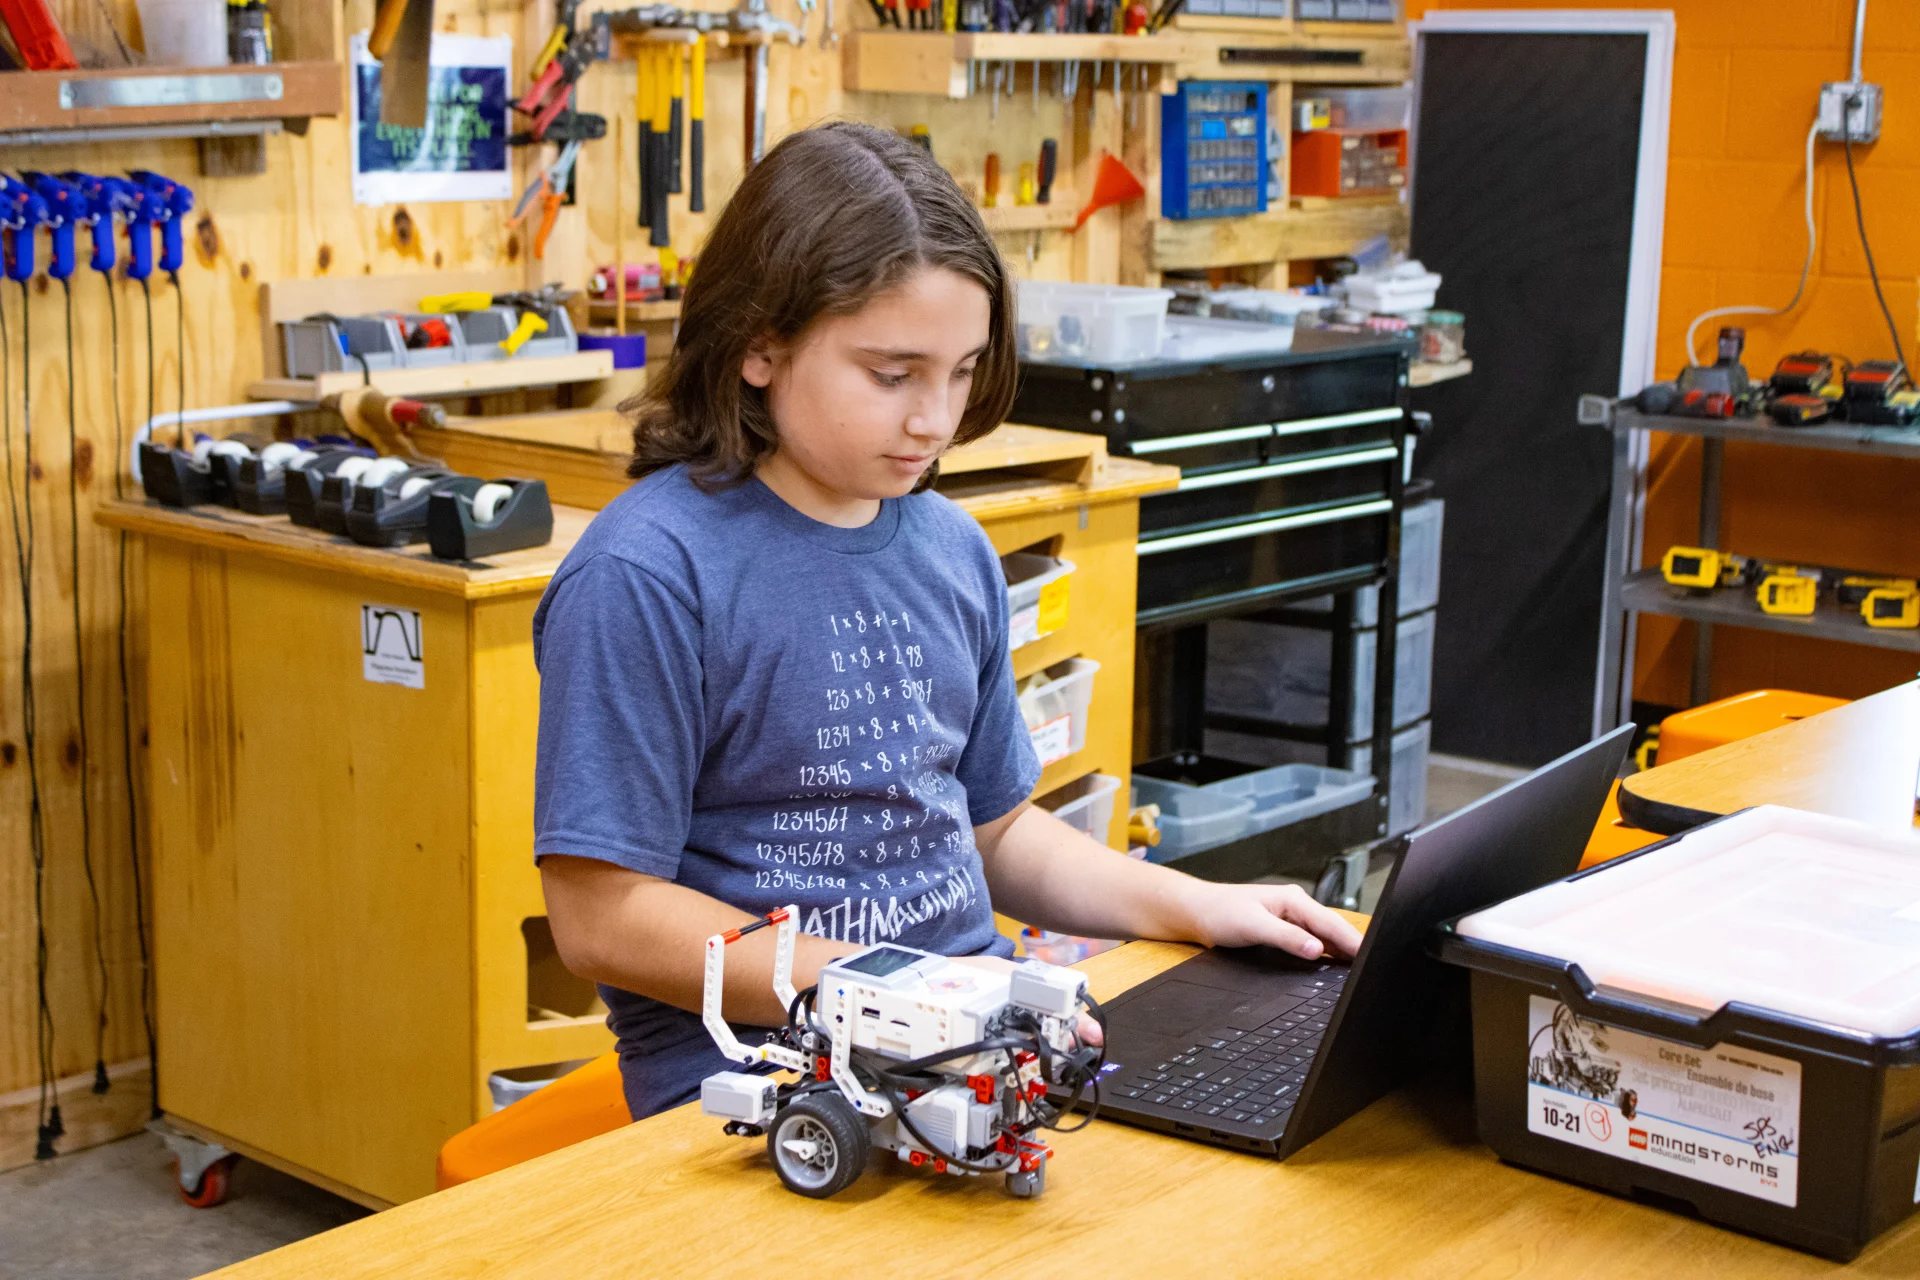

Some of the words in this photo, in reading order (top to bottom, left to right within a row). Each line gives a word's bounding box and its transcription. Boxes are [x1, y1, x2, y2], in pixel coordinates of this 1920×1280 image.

[831, 615, 838, 636] 1
[855, 610, 866, 633] 8
[831, 651, 846, 673] 12
[860, 646, 871, 669] 8
[877, 650, 886, 663] +
[893, 644, 903, 665] 2
[906, 645, 923, 668] 98
[826, 688, 849, 711] 123
[865, 682, 876, 704] 8
[882, 685, 891, 699] +
[817, 725, 851, 750] 1234
[870, 717, 884, 740] 8
[891, 720, 900, 733] +
[907, 714, 918, 734] 4
[799, 759, 852, 786] 12345
[877, 751, 893, 773] 8
[900, 753, 908, 766] +
[772, 806, 849, 833] 1234567
[881, 809, 894, 831] 8
[902, 815, 913, 828] +
[756, 841, 845, 867] 12345678
[876, 841, 887, 864] 8
[894, 845, 904, 858] +
[910, 836, 921, 859] 8
[899, 876, 909, 886] +
[915, 870, 929, 884] 9
[1658, 1047, 1682, 1064] Core
[1684, 1053, 1702, 1069] Set
[1543, 1106, 1580, 1134] 10-21
[1650, 1146, 1696, 1165] education
